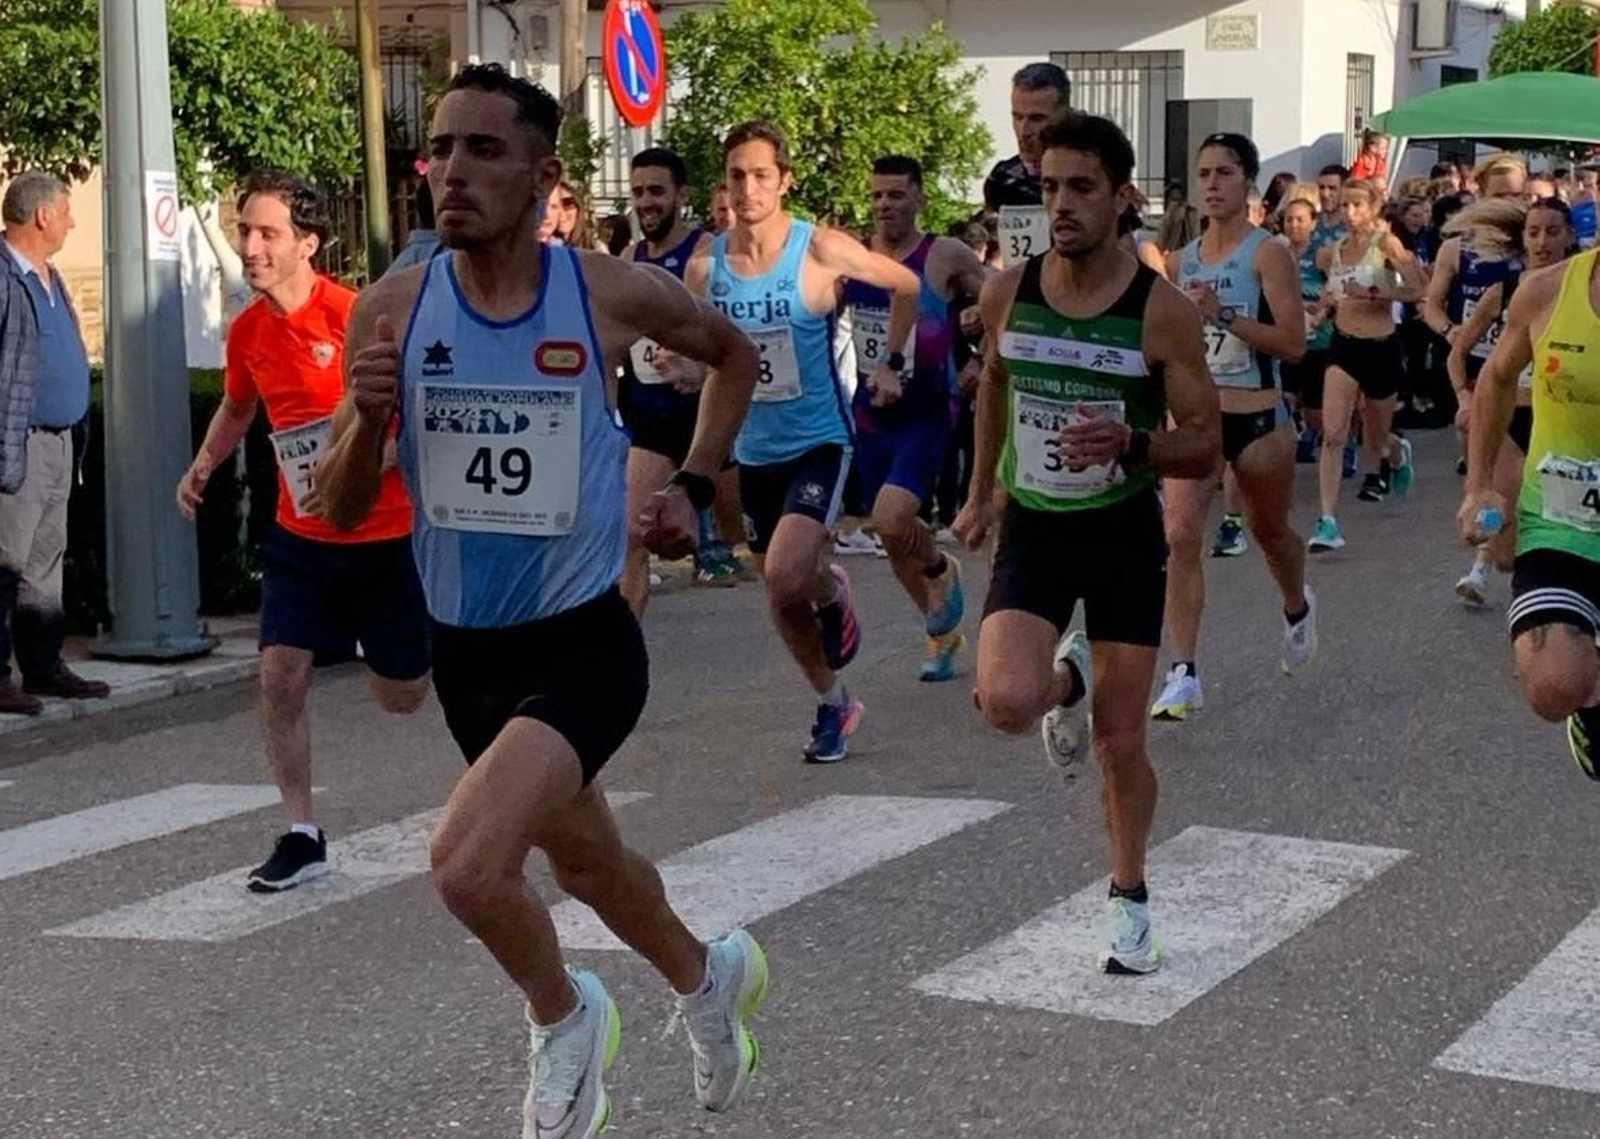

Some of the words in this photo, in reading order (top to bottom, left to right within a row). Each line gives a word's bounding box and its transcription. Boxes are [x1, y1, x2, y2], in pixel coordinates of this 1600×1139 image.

[1010, 235, 1033, 258] 32
[465, 446, 533, 496] 49
[1044, 439, 1090, 474] 3
